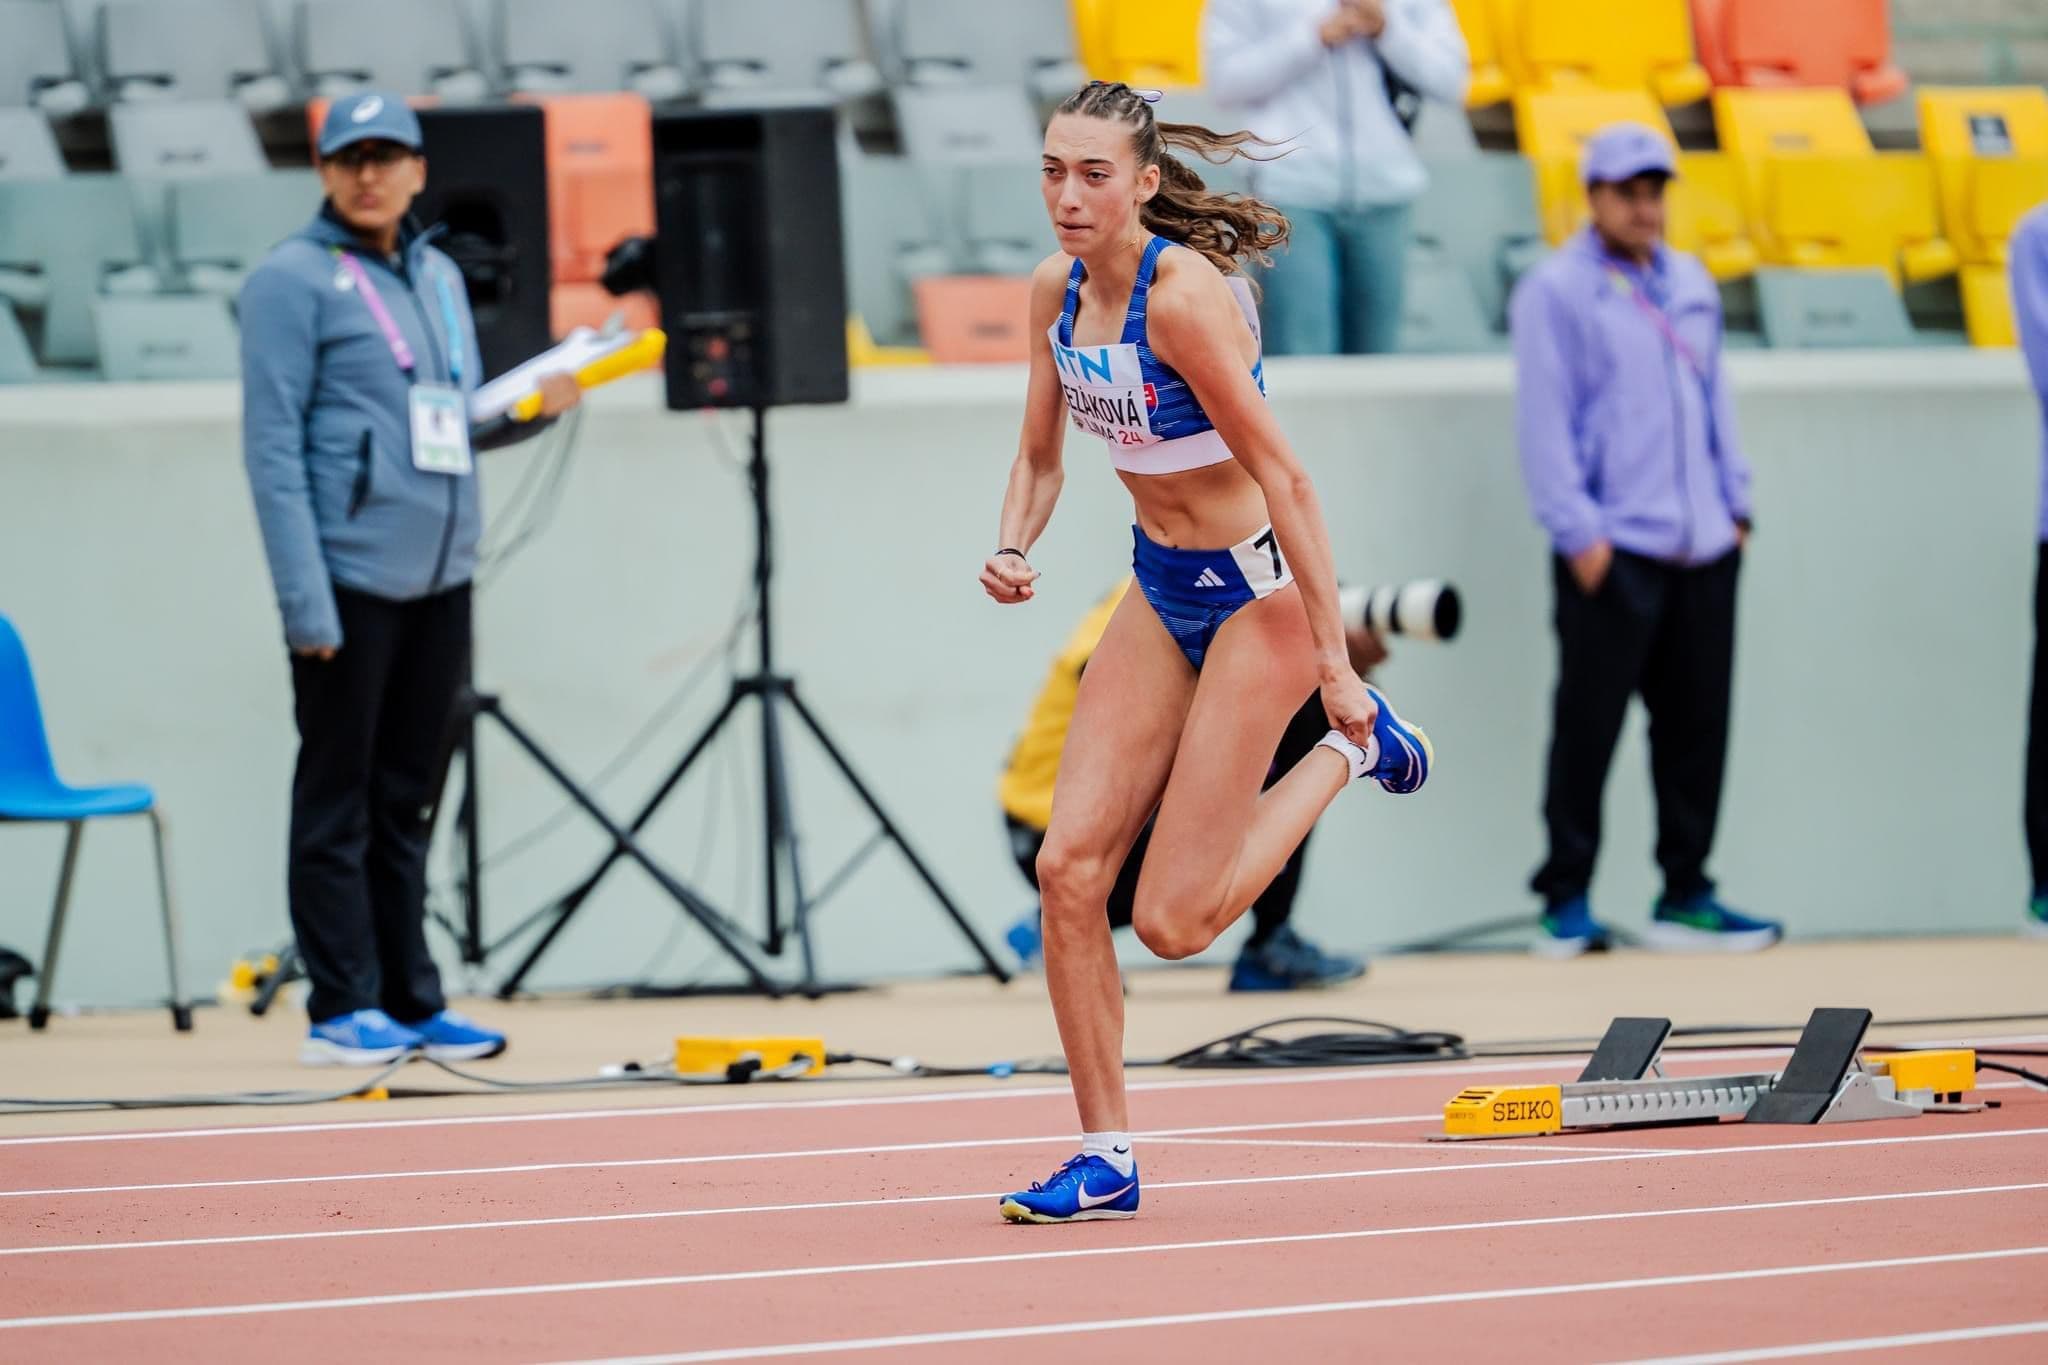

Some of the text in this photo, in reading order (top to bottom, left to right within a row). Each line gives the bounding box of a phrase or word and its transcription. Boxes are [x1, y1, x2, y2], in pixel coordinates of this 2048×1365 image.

[1063, 384, 1142, 427] EZÁKOVÁ
[1118, 430, 1144, 445] 24
[1254, 528, 1282, 580] 7
[1493, 1100, 1554, 1121] SEIKO
